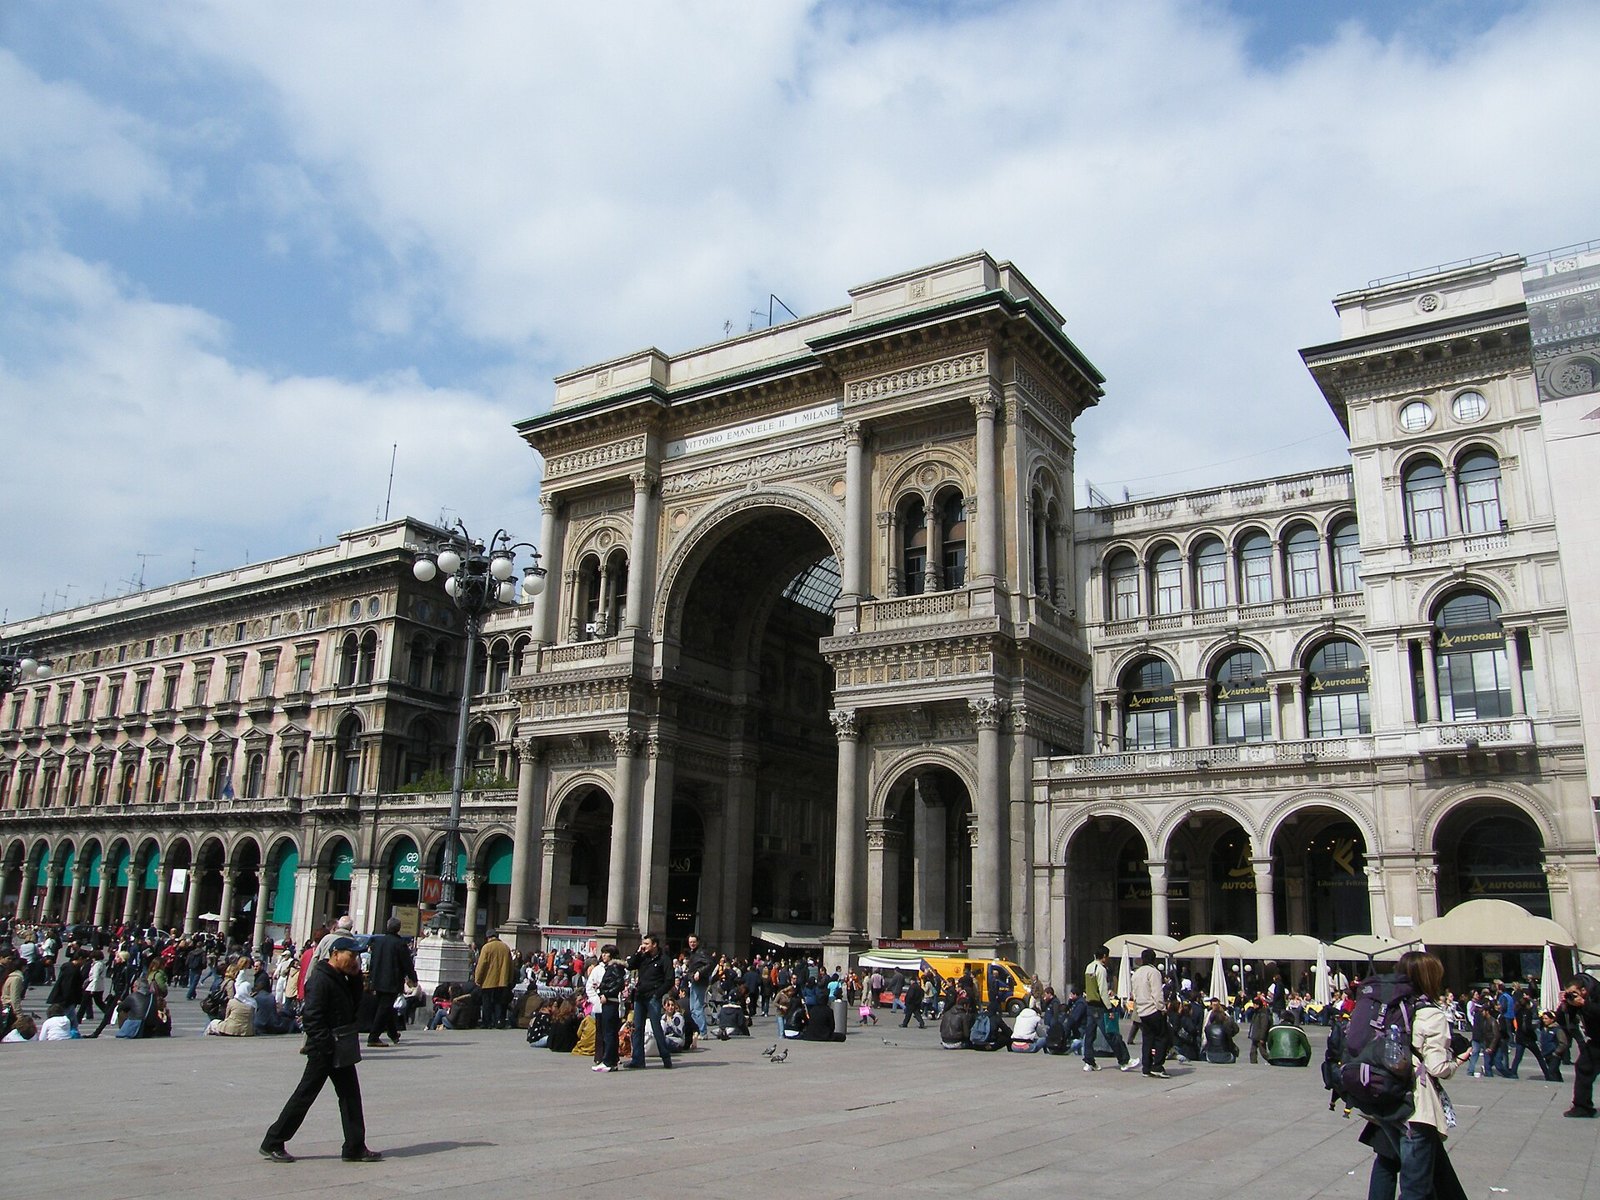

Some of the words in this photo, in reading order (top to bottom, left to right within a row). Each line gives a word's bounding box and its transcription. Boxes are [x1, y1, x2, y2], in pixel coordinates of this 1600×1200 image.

[685, 436, 723, 449] VITTORIO
[727, 422, 774, 439] EMANUELE
[1454, 632, 1503, 643] AUTOGRILL
[1325, 677, 1366, 687] AUTOGRILL
[1220, 881, 1256, 890] AUTOG
[1487, 881, 1542, 890] AUTOGRILL
